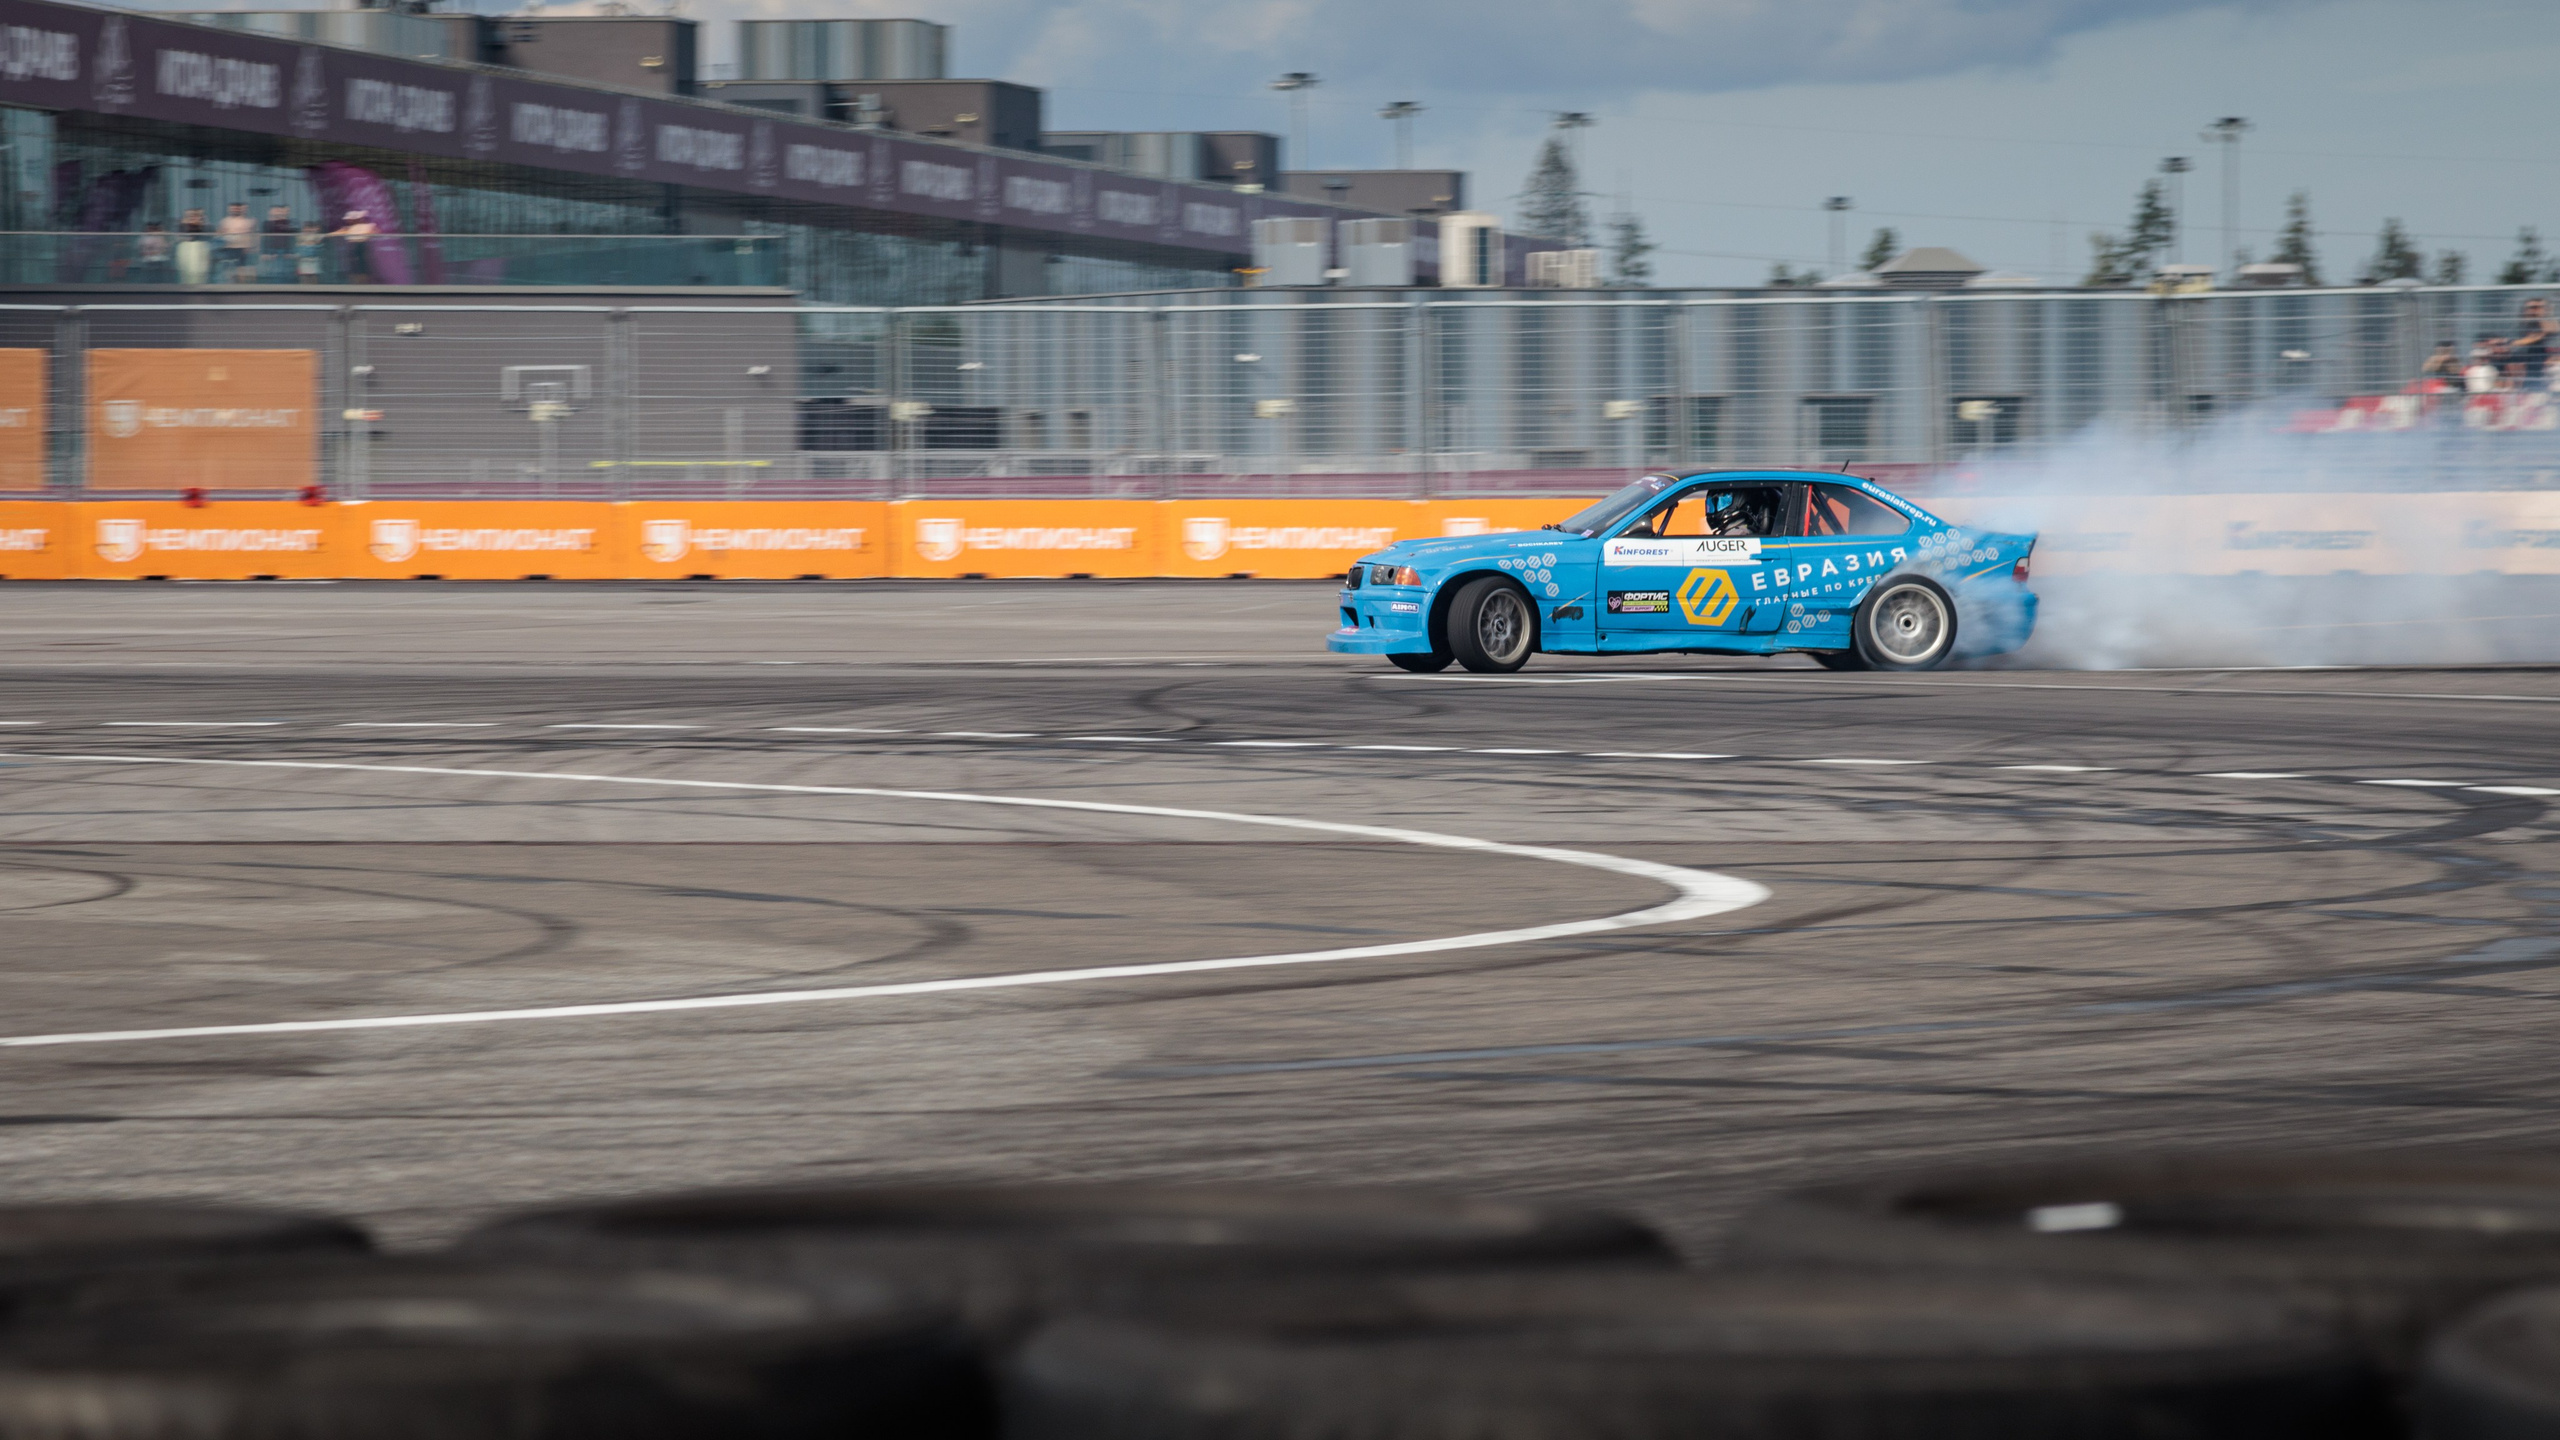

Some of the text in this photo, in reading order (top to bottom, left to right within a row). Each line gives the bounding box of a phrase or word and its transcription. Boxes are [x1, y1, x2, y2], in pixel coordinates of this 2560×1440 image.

[1861, 481, 1938, 528] eurasiakrep.ru
[1614, 545, 1669, 556] KINFOREST
[1696, 540, 1748, 552] AUGER
[1751, 547, 1908, 591] ЕВРАЗИЯ
[1624, 592, 1668, 601] ФОРТИС
[1755, 587, 1819, 606] ГЛАВНЫЕ
[1825, 582, 1843, 593] ПО
